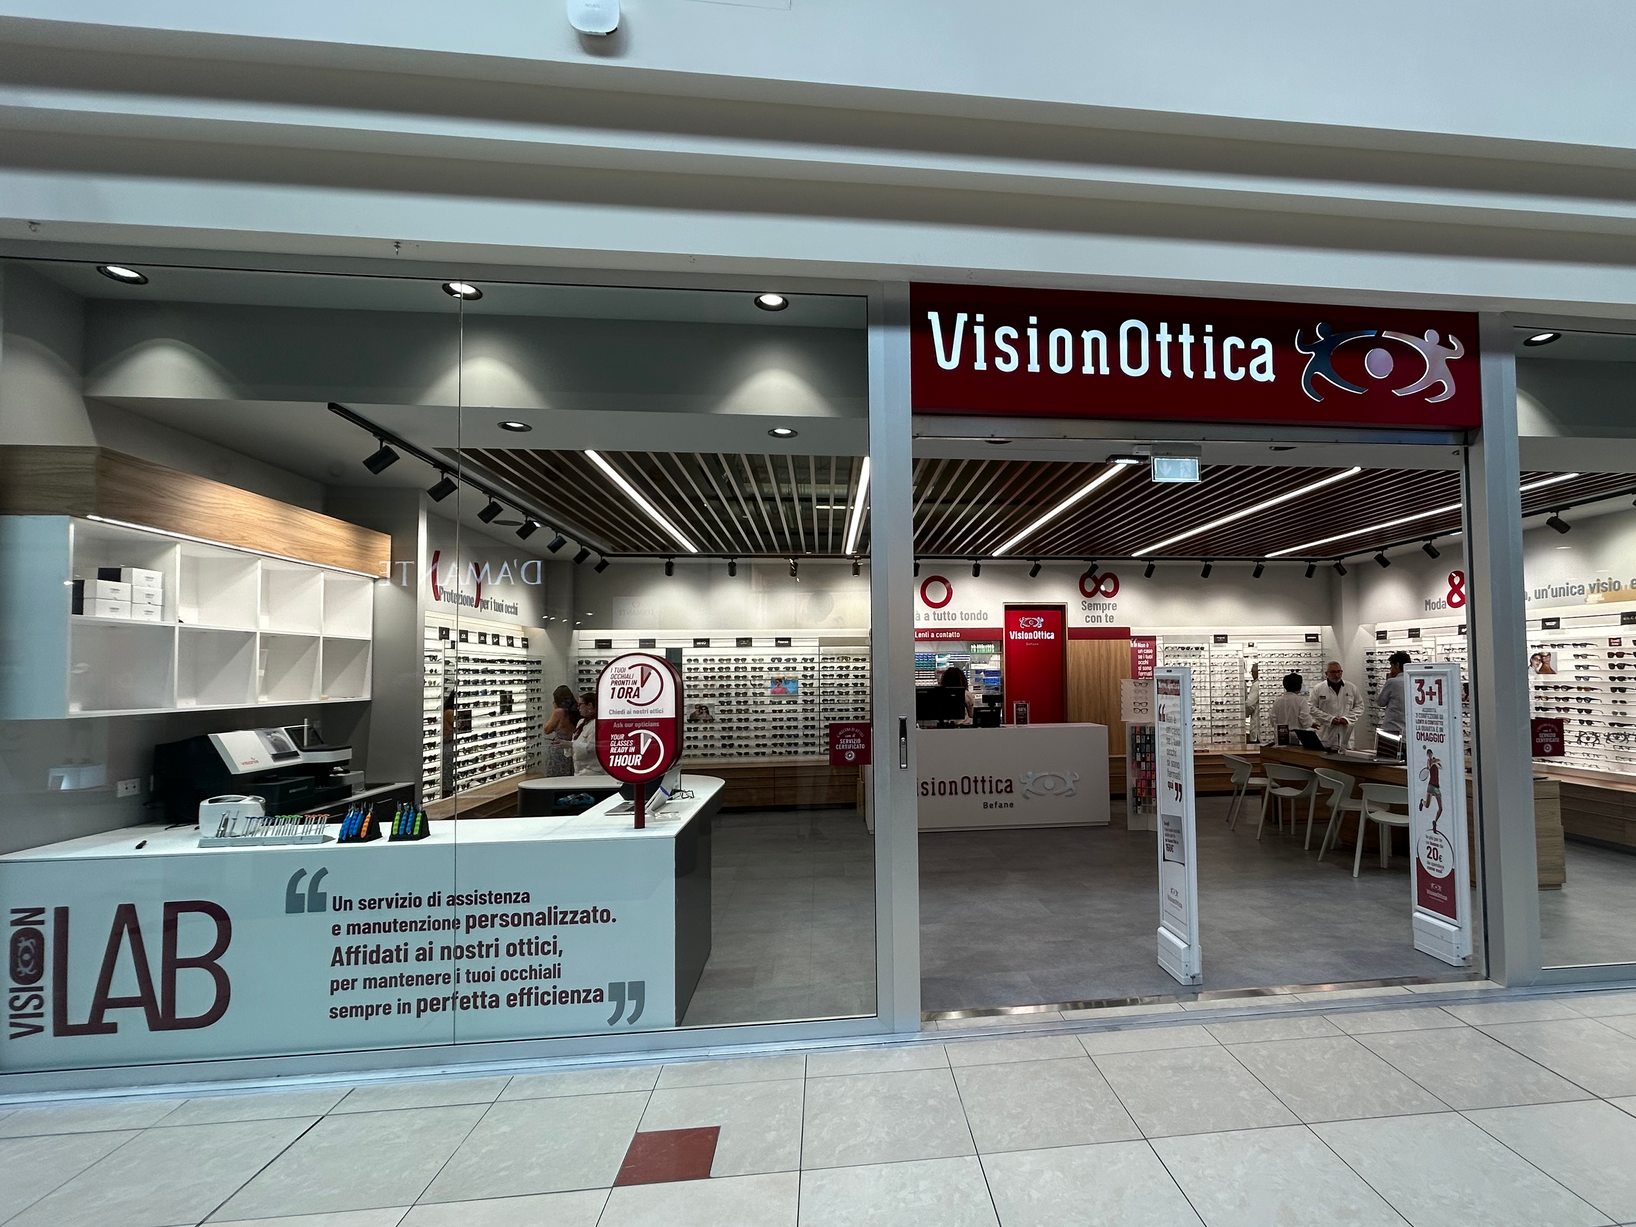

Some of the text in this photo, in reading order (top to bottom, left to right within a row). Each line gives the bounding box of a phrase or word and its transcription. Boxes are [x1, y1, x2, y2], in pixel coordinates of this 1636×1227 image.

[927, 311, 1276, 383] VisionOttica
[1534, 582, 1585, 600] un'unica
[1081, 600, 1118, 614] Sempre
[1424, 598, 1446, 611] Moda
[932, 611, 957, 621] tutto
[960, 610, 988, 621] tondo
[1085, 613, 1114, 624] con te
[1009, 630, 1055, 640] VisionOttica
[617, 687, 640, 699] ORA
[1414, 679, 1443, 706] 3+1
[917, 775, 1014, 796] isionOttica
[983, 801, 1014, 809] Befane
[1426, 846, 1442, 862] 20€
[332, 889, 530, 912] Un servizio di assistenza
[332, 905, 617, 936] e manutenzione personalizzato.
[330, 934, 563, 968] Affidati ai nostri ottici,
[53, 900, 232, 1037] LAB
[330, 962, 562, 996] per mantenere i tuoi occhiali
[329, 984, 604, 1020] sempre in perfetta efficienza
